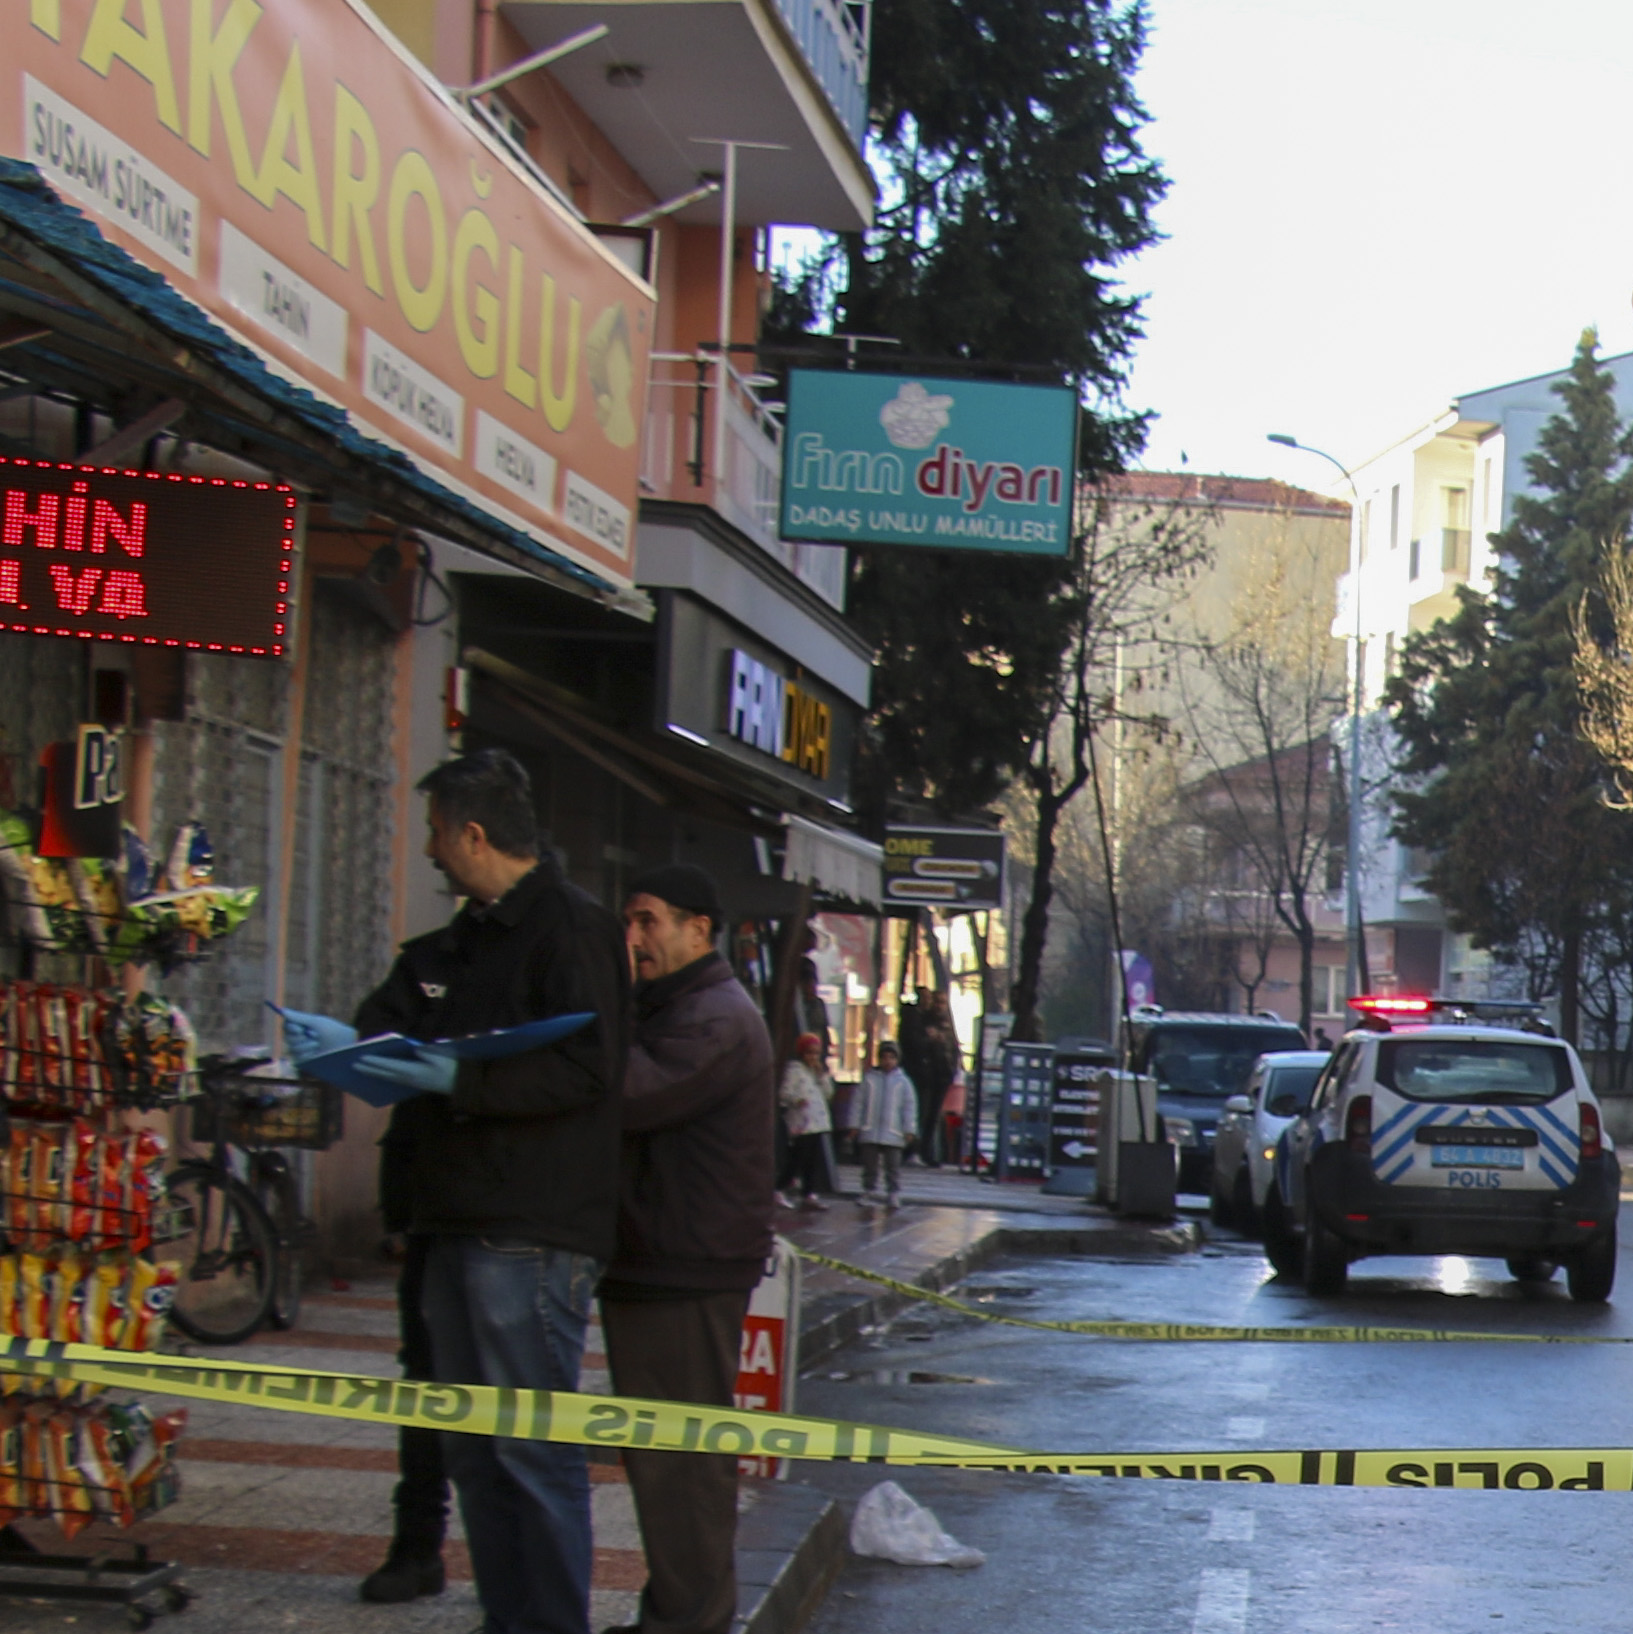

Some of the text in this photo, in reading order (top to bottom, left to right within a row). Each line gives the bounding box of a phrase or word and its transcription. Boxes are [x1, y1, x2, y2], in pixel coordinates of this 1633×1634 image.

[34, 101, 191, 258] SUSAM SÜRTME
[28, 0, 580, 434] AKAROĞLU
[262, 269, 309, 340] TAHİN
[495, 435, 536, 491] HELVA
[916, 443, 1062, 514] diyarı
[790, 505, 1058, 543] DADAŞ UNLU MAMÜLLERİ
[1448, 1169, 1501, 1189] POLİS
